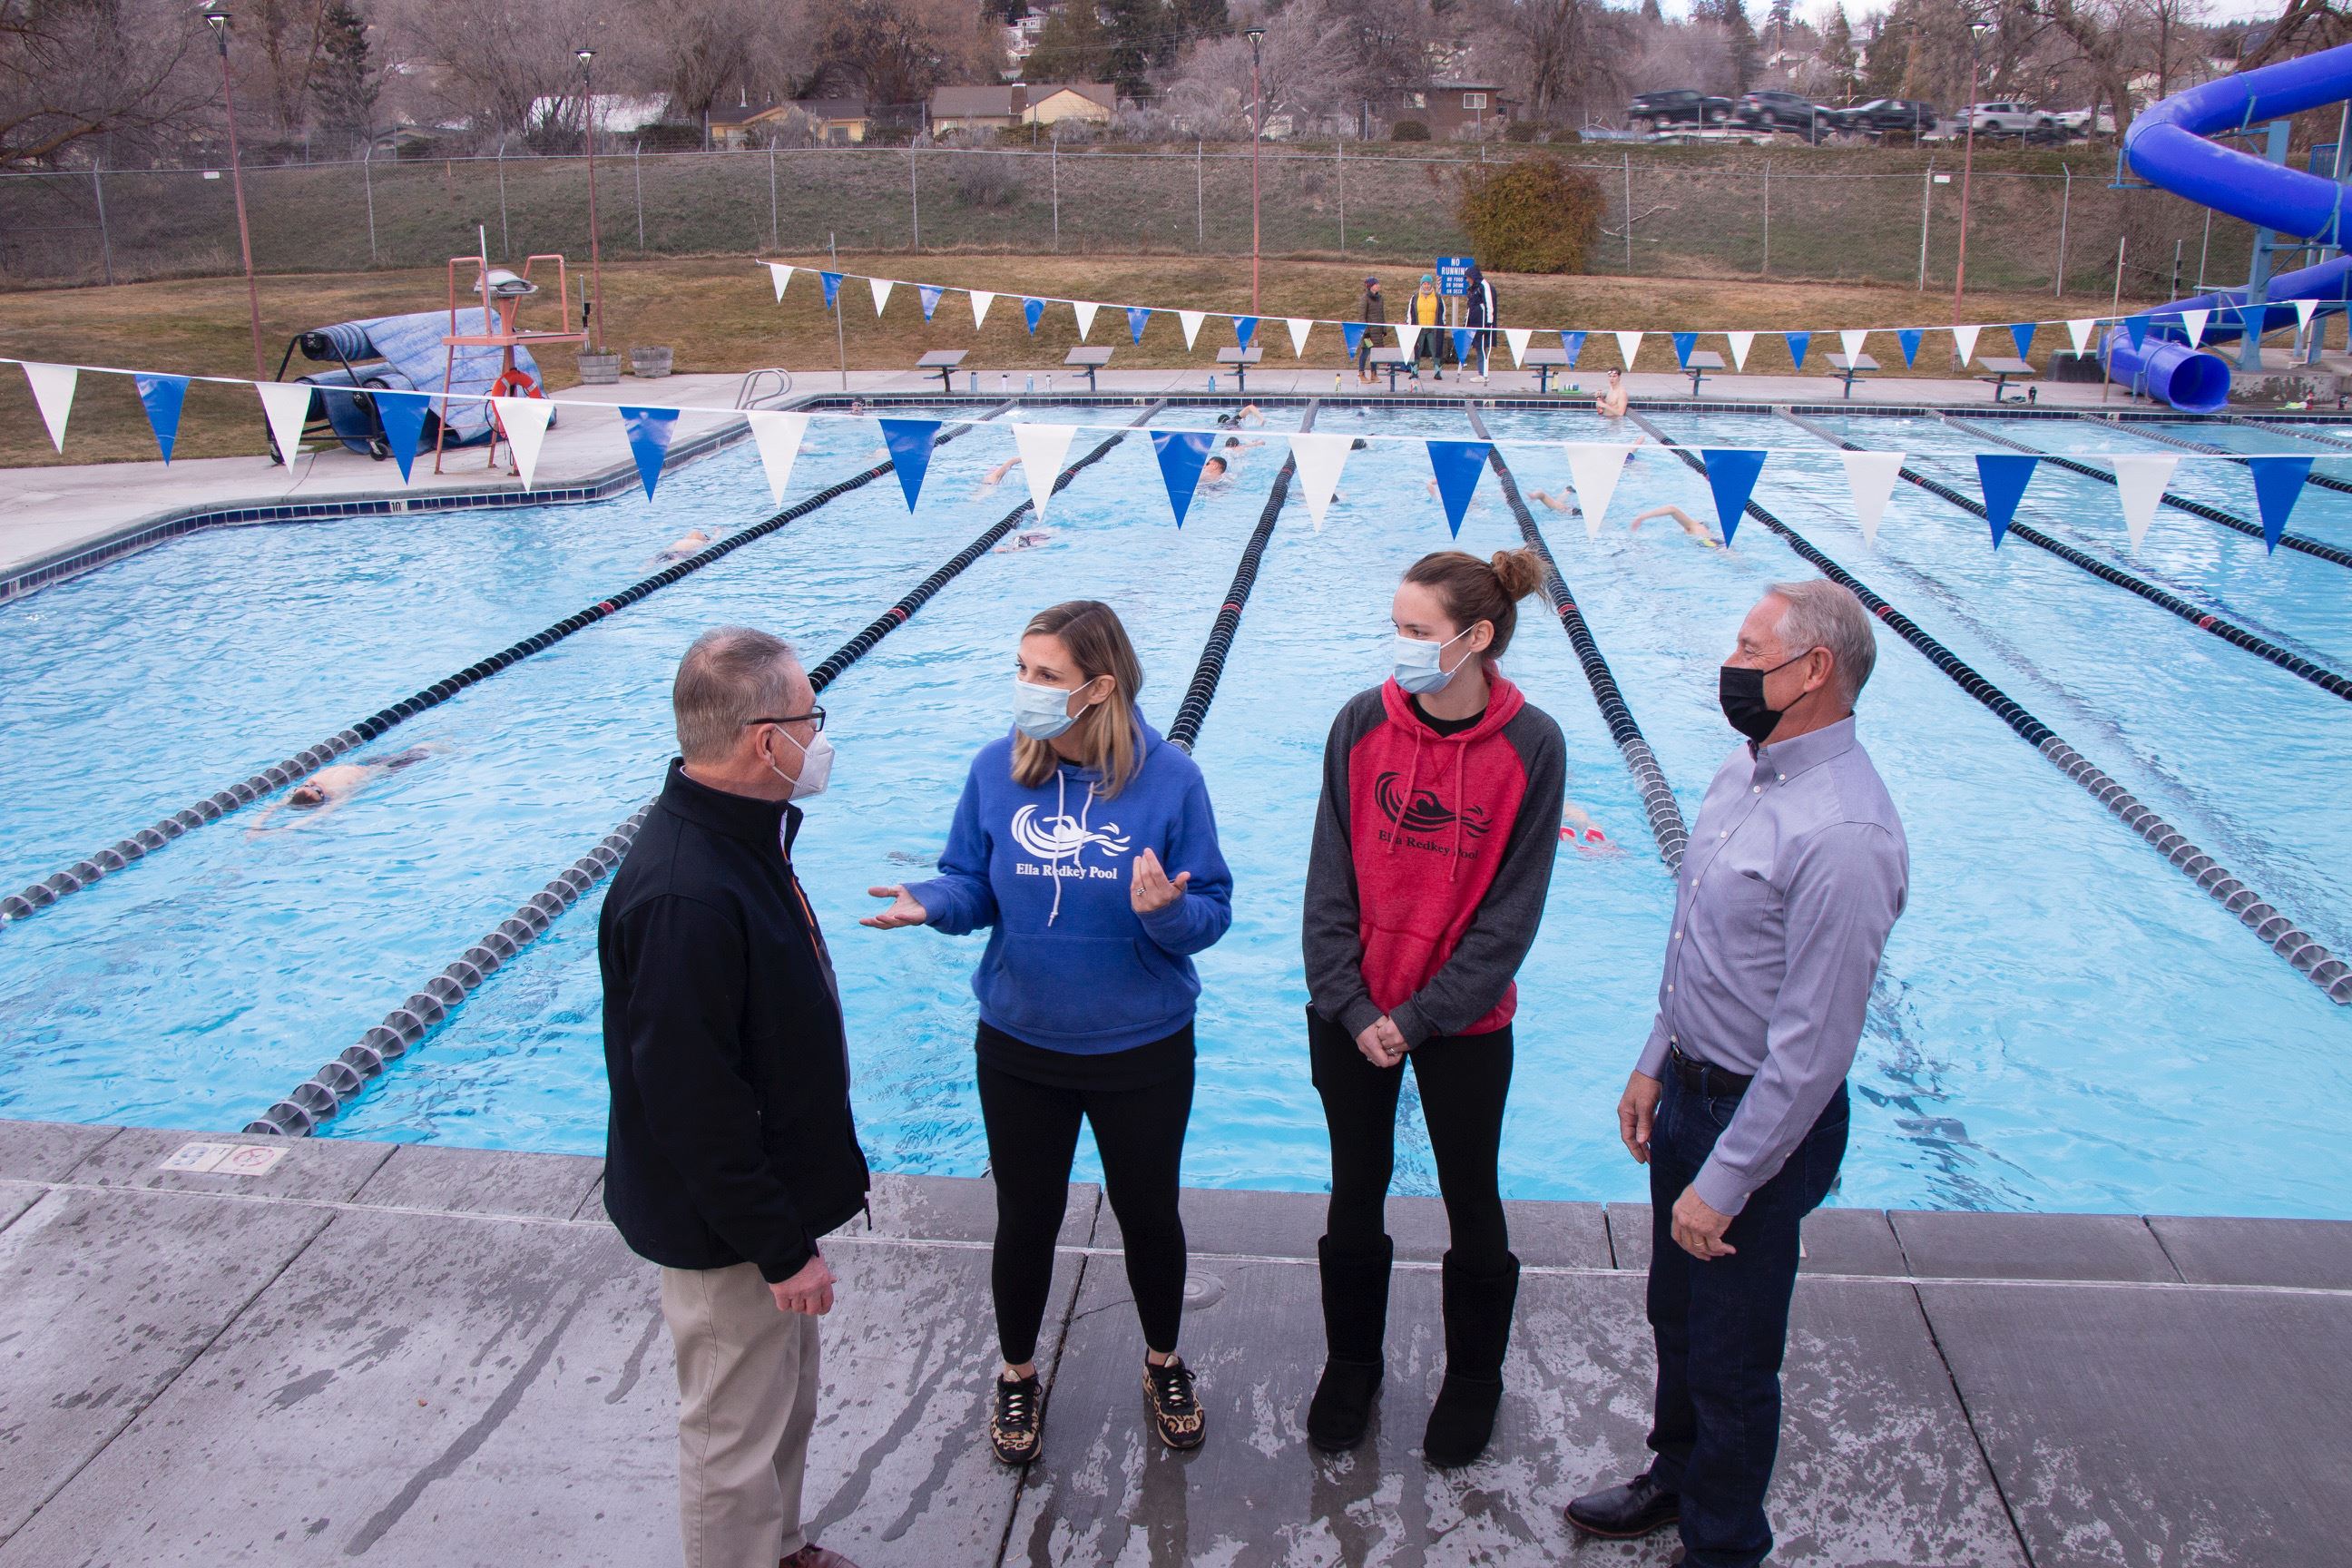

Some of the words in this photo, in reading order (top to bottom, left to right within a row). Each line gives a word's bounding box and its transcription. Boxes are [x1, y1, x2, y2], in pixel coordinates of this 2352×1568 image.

[1451, 258, 1460, 266] NO
[1441, 267, 1468, 275] RUNNIN
[1378, 829, 1402, 845] Ela
[1406, 837, 1450, 856] Redkey
[1015, 863, 1040, 875] Ella
[1089, 866, 1118, 879] Pool
